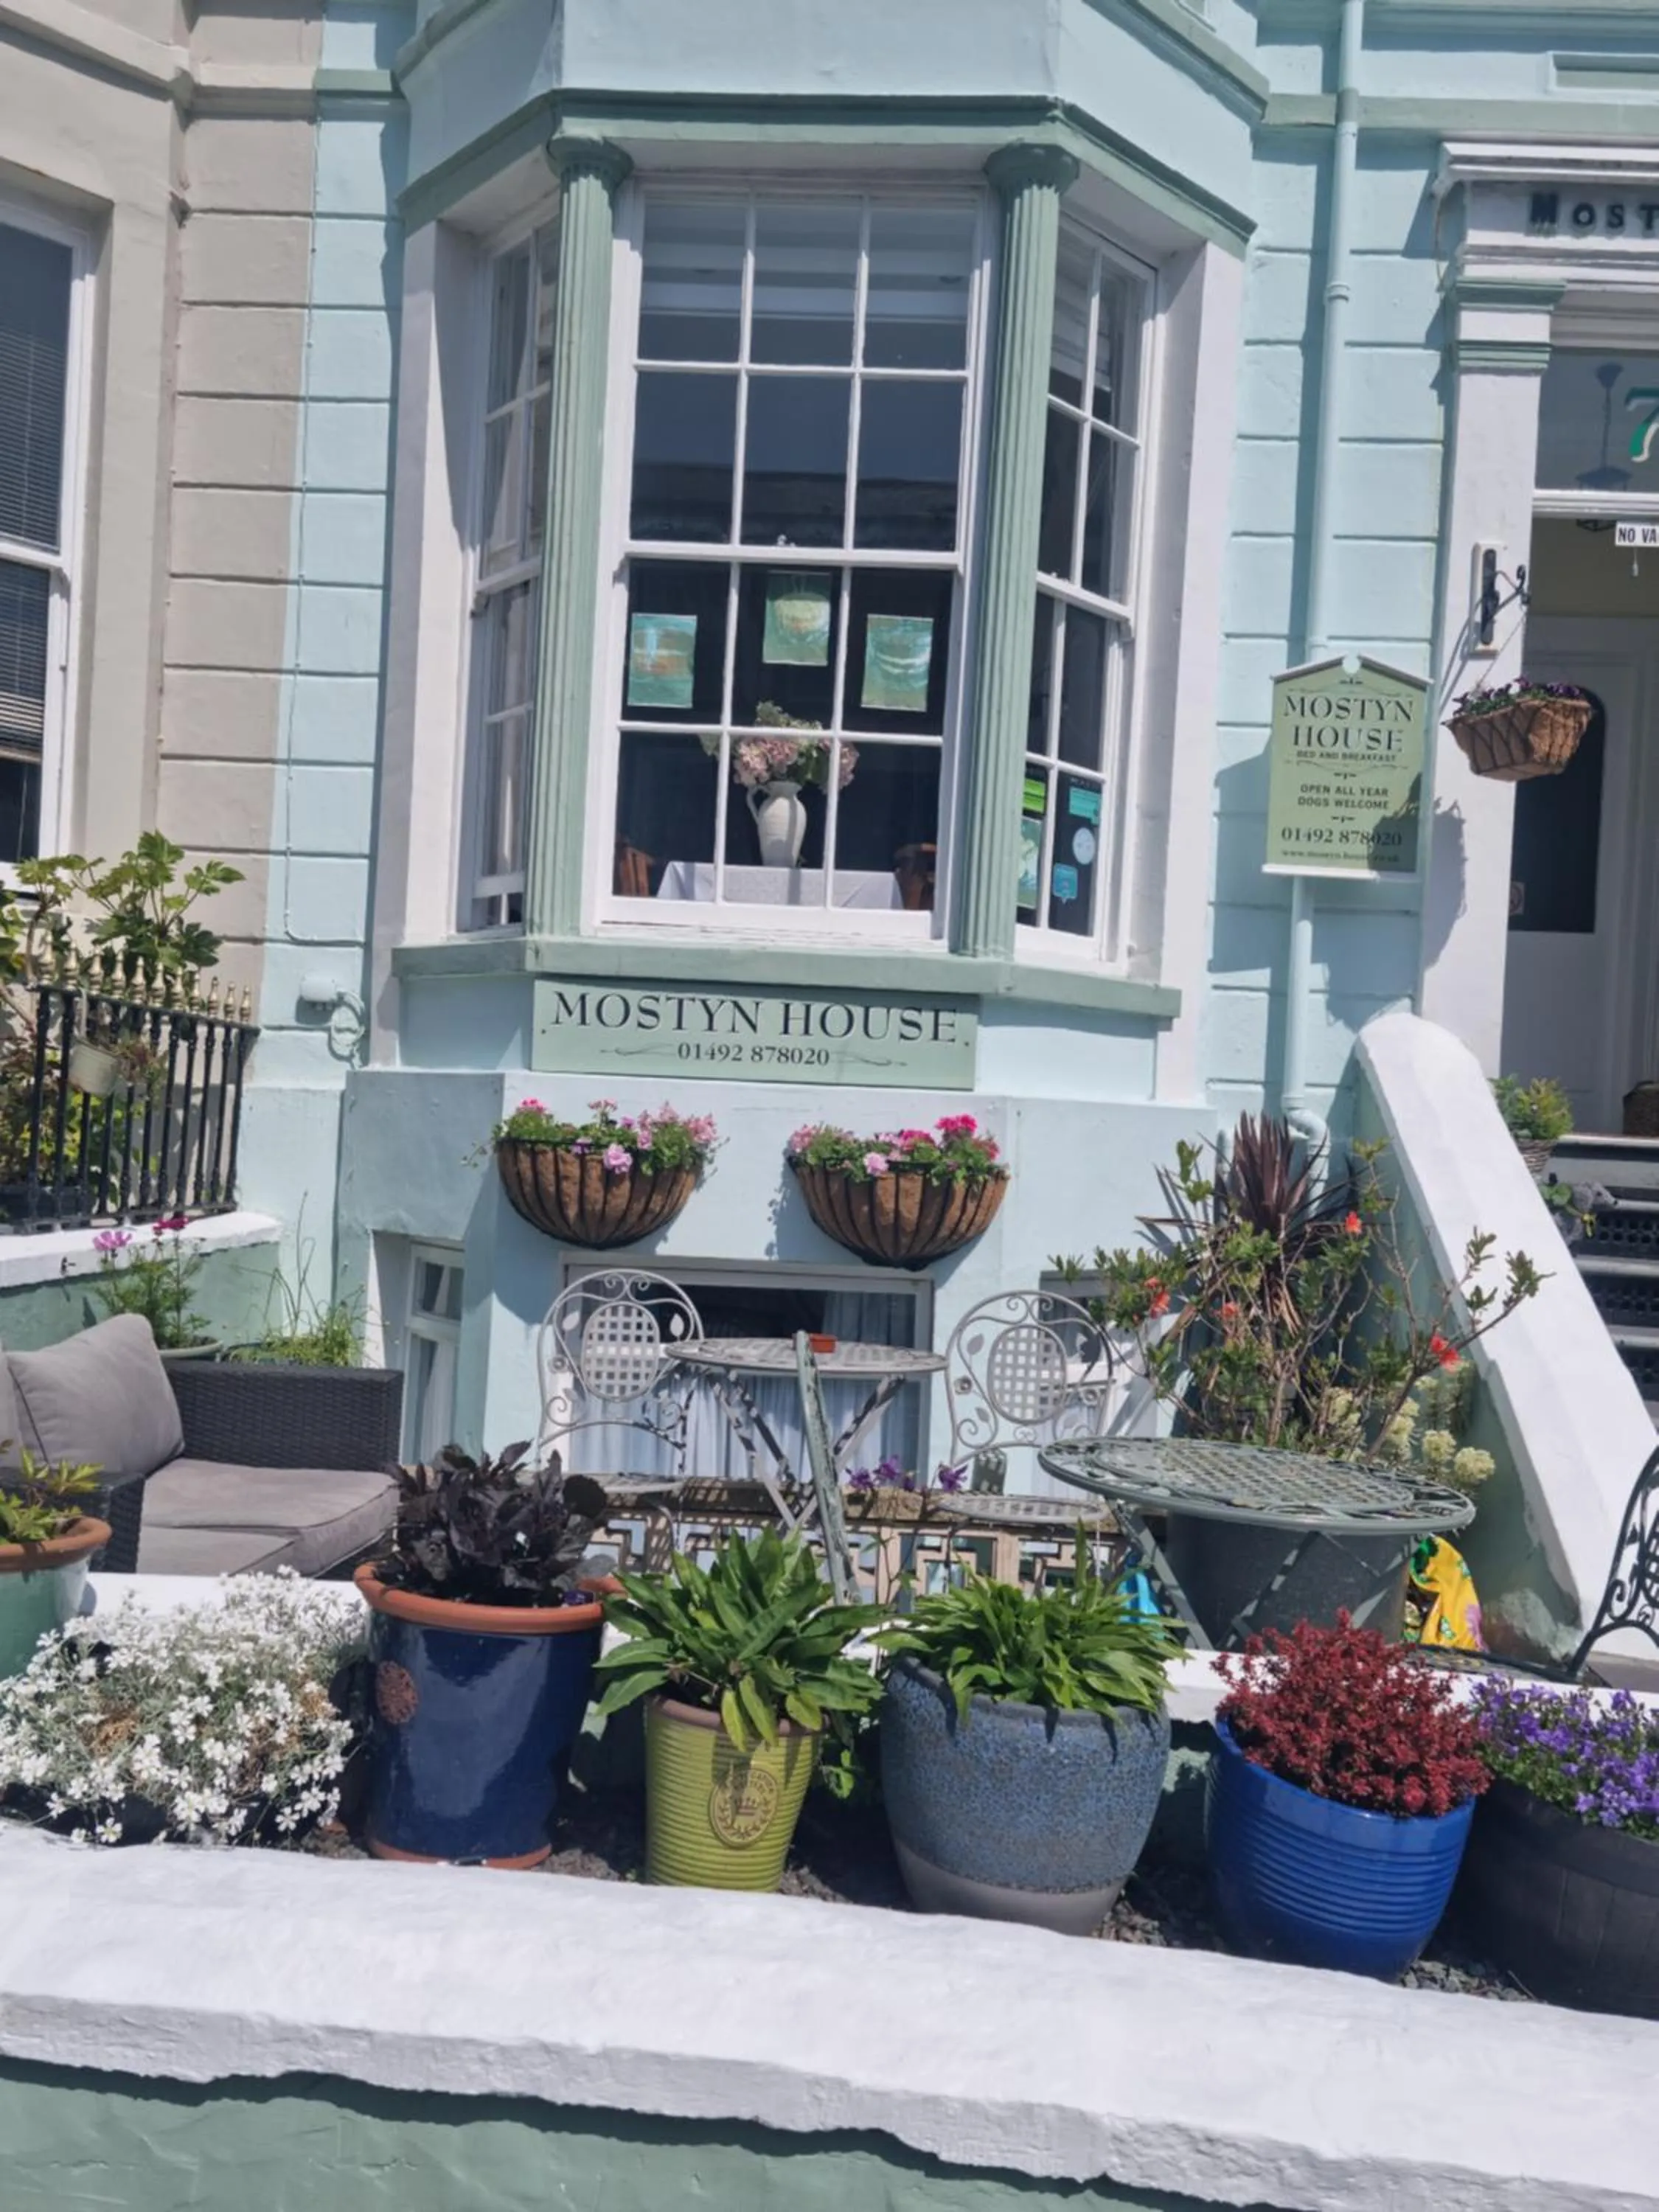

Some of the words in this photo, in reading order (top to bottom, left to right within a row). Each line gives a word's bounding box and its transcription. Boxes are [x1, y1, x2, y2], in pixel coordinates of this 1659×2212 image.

[1618, 527, 1635, 543] NO
[1284, 695, 1414, 722] MOSTYN
[1293, 726, 1404, 752] HOUSE
[1341, 752, 1397, 762] BREAKFAST
[1300, 784, 1330, 795] OPEN
[1335, 786, 1355, 796] ALL
[1360, 787, 1389, 798] YEAR
[1298, 796, 1329, 807] DOGS
[1335, 799, 1389, 810] WELCOME
[1281, 827, 1333, 844] 01492
[1338, 829, 1402, 846] 878020
[551, 990, 762, 1034] MOSTYN
[779, 1001, 956, 1043] HOUSE
[678, 1041, 743, 1062] 01492
[750, 1045, 830, 1065] 878020
